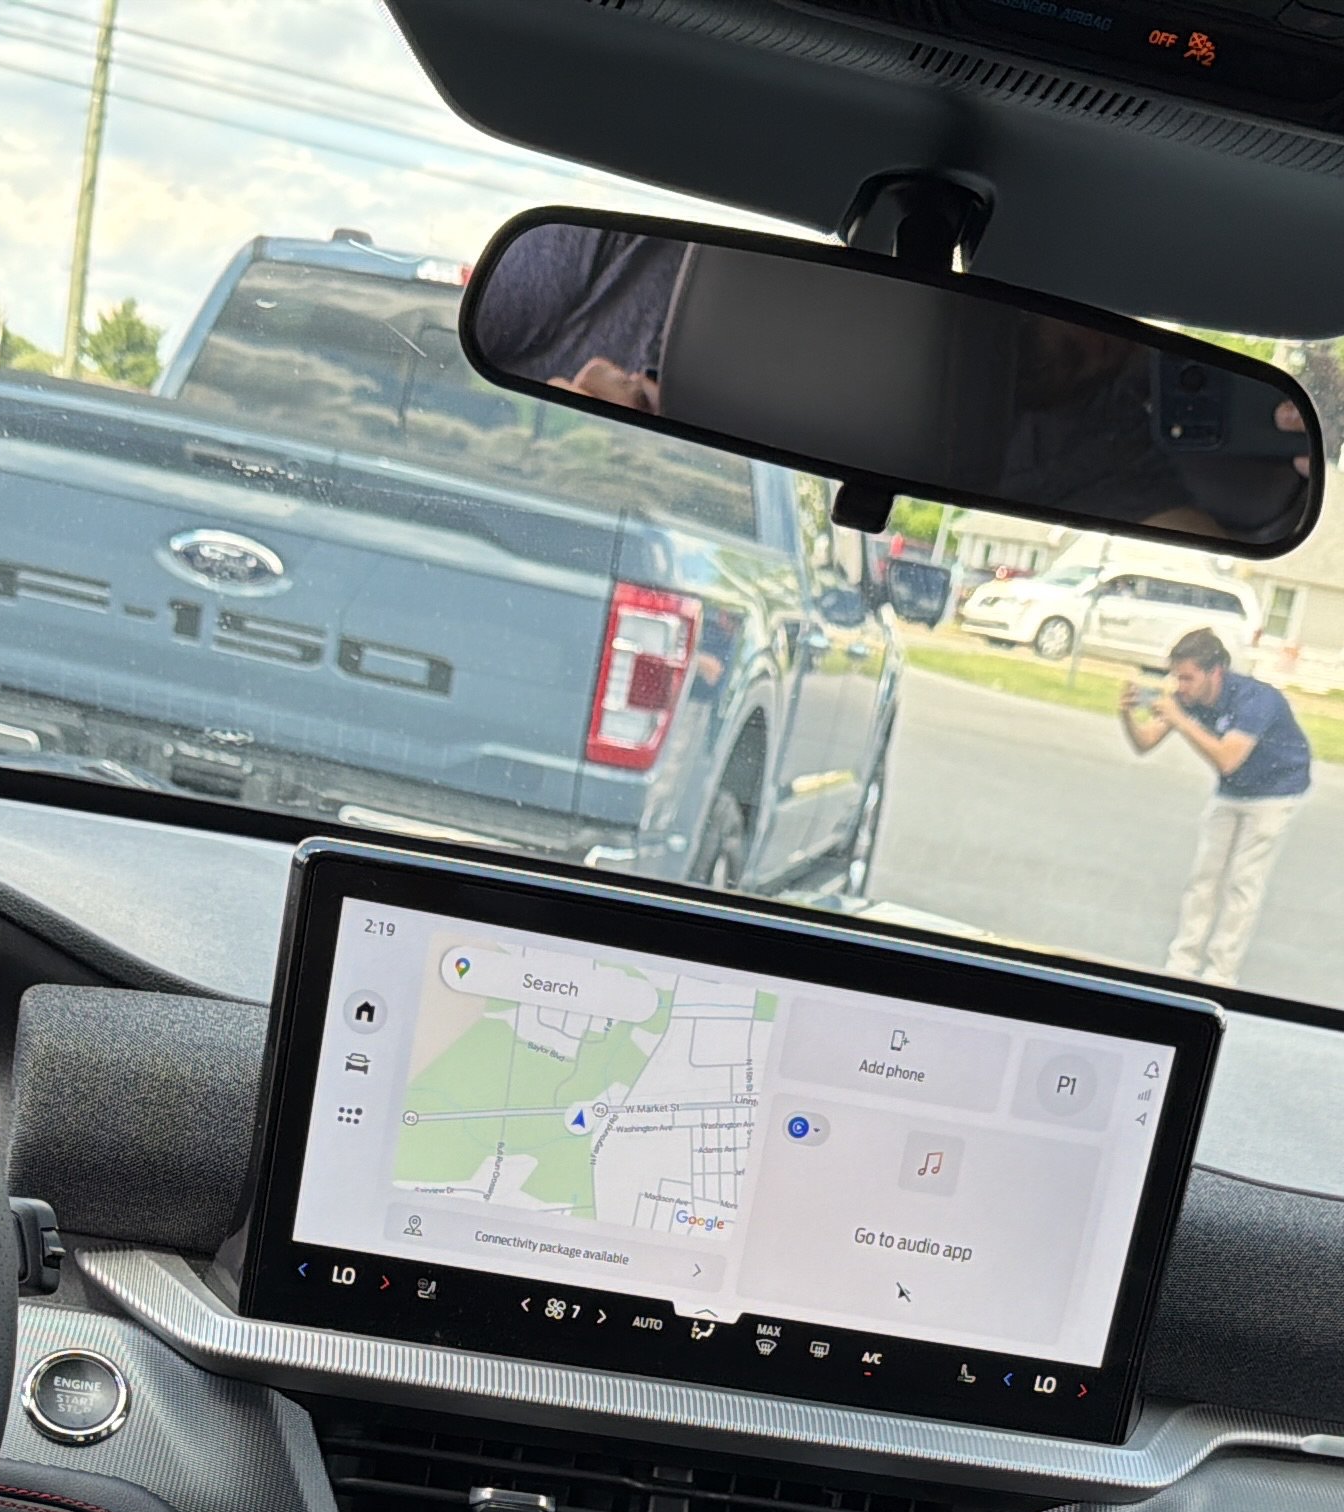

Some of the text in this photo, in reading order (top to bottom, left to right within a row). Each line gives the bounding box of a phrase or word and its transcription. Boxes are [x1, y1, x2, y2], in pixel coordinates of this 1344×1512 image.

[1148, 30, 1178, 48] OFF
[364, 918, 396, 937] 2:19
[522, 973, 578, 998] Search
[859, 1059, 925, 1083] Add phone
[1056, 1075, 1077, 1096] P1
[636, 1104, 669, 1113] Market
[676, 1210, 724, 1231] Google
[475, 1230, 630, 1265] Connectivity package available
[854, 1227, 973, 1263] Go to audio app
[331, 1265, 1057, 1394] LO 7 AUTO MAX A/C LO
[54, 1375, 102, 1392] ENGINE
[56, 1393, 94, 1407] START
